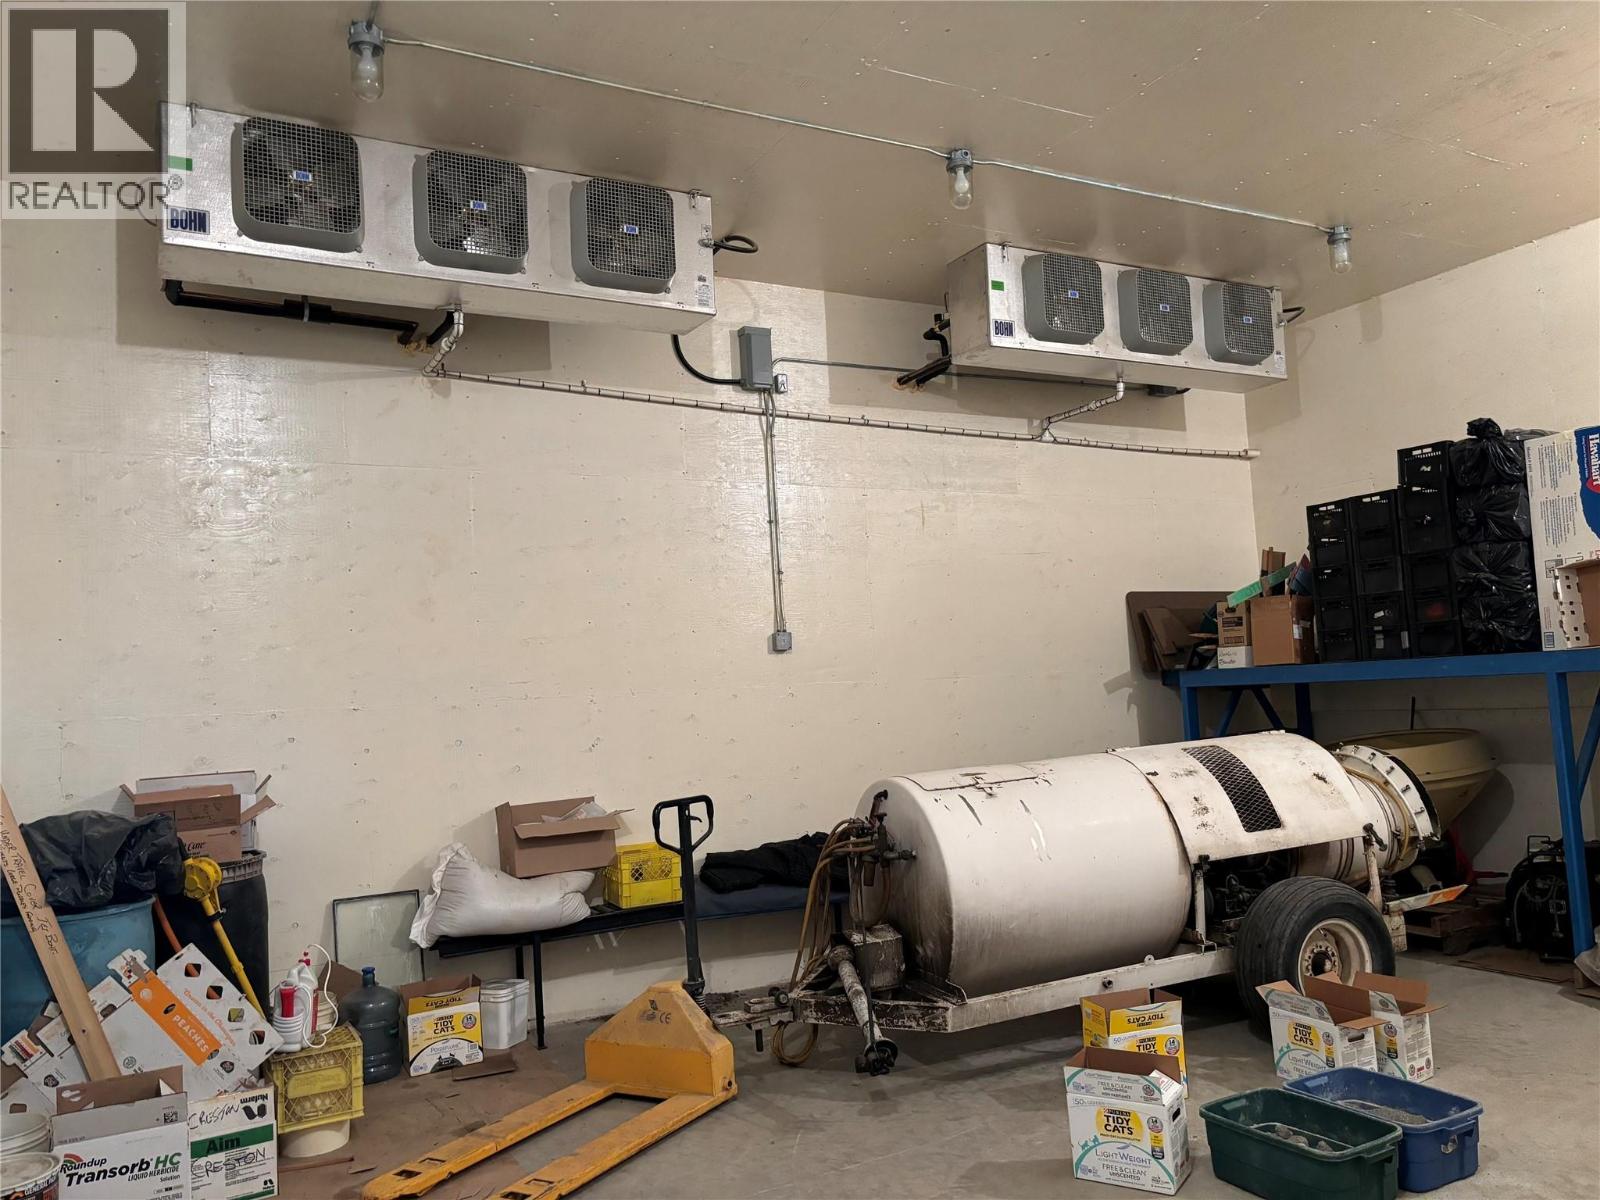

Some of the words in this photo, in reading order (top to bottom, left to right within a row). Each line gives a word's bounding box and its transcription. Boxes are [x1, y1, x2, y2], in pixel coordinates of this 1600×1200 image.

[170, 208, 207, 233] BOHN
[994, 320, 1013, 337] BOHN
[660, 1012, 671, 1024] CE
[1127, 1016, 1146, 1024] CATS
[1147, 1013, 1164, 1021] TIDY
[434, 1020, 453, 1028] TIDY
[172, 1014, 209, 1052] PEACHES
[1293, 1027, 1312, 1037] TIDY
[1293, 1034, 1314, 1046] CATS
[1136, 1043, 1157, 1051] TIDY
[240, 1094, 268, 1104] Nufarm
[1104, 1115, 1131, 1125] TIDY
[1104, 1124, 1134, 1135] CATS
[206, 1137, 240, 1155] Aim
[60, 1158, 107, 1174] Roundup
[191, 1147, 266, 1178] CRESTON
[65, 1158, 150, 1187] Transorb
[154, 1152, 182, 1169] HC
[1102, 1164, 1118, 1172] FREE
[1125, 1167, 1147, 1176] CLEAN
[1109, 1172, 1141, 1181] UNSCENTED
